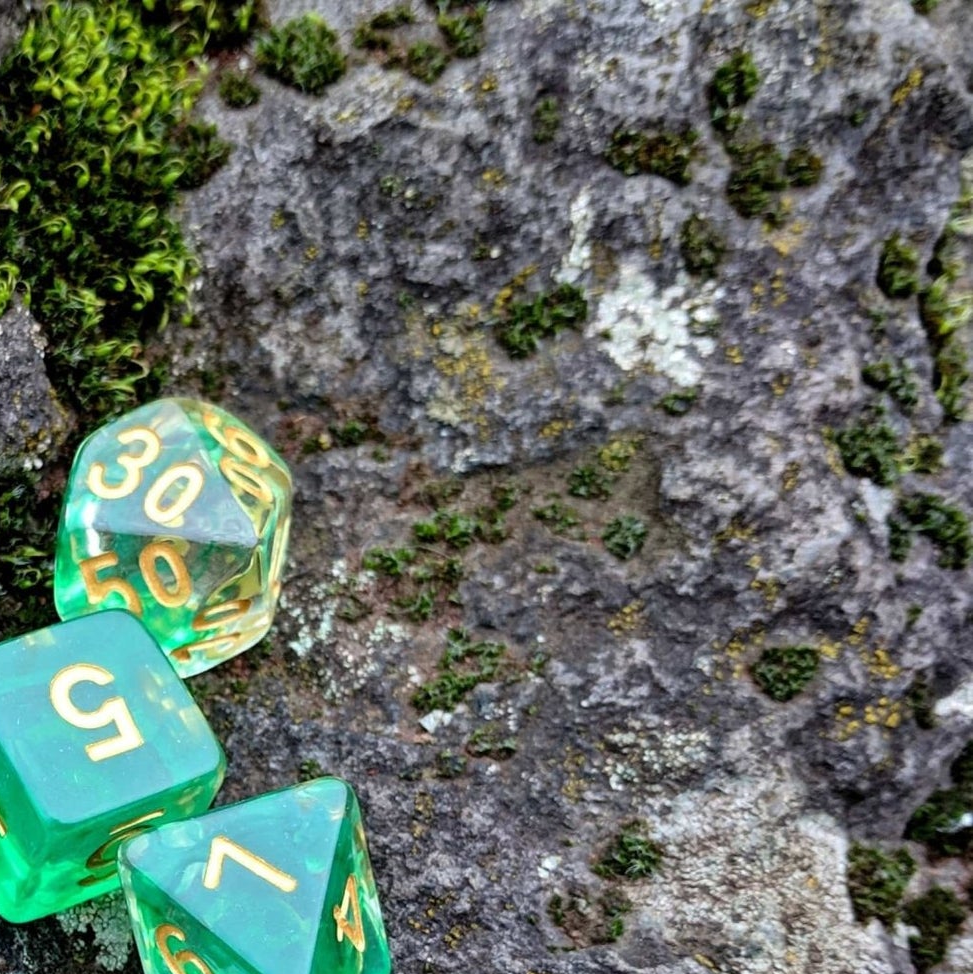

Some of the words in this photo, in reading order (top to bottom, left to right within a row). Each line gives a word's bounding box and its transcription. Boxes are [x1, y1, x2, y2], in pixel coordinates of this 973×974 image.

[87, 425, 205, 527] 30
[78, 542, 193, 618] 50
[49, 663, 145, 763] 5
[333, 873, 366, 953] 4
